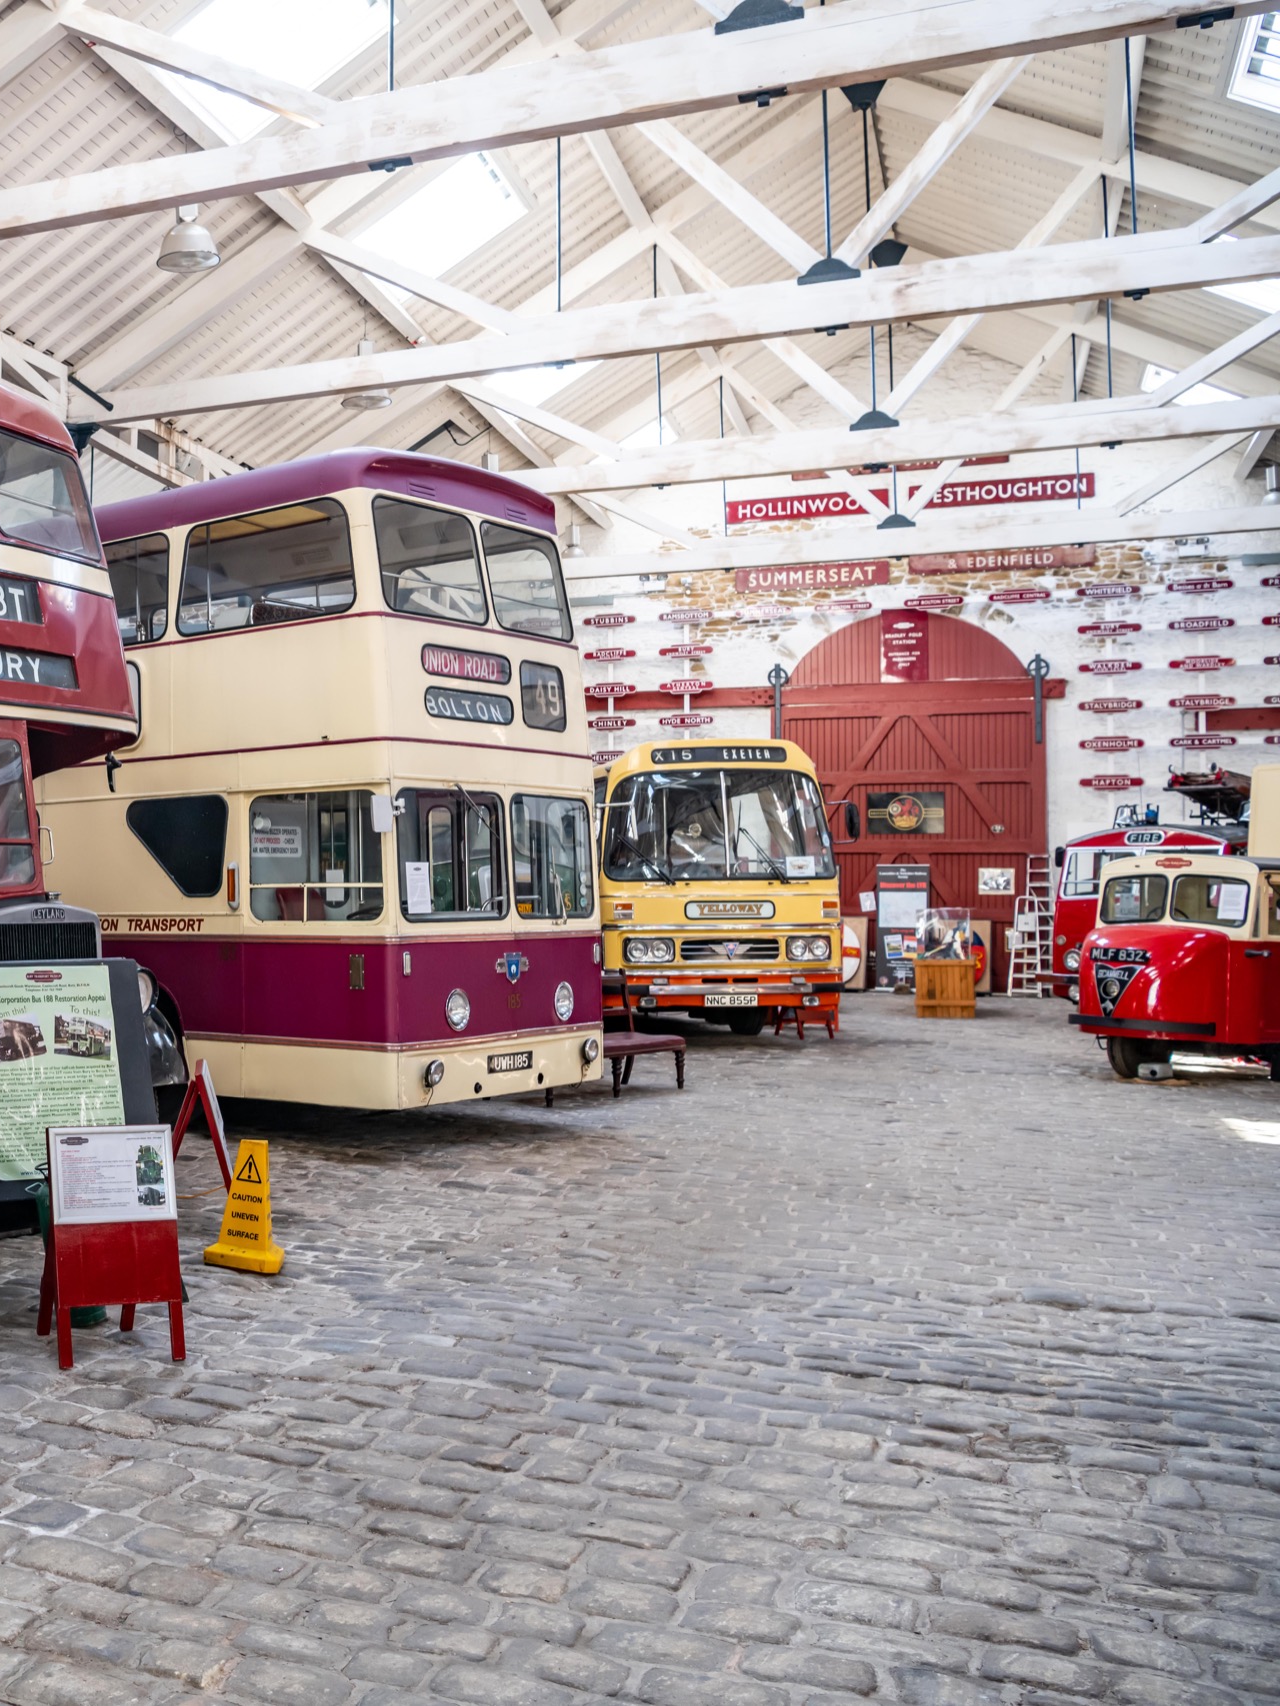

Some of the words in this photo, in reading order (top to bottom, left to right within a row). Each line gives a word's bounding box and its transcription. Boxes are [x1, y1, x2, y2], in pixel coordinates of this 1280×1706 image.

[914, 478, 1087, 503] ESTHOUGHTON
[738, 497, 860, 519] HOLLINWOO
[967, 553, 1054, 568] EDENFIELD
[748, 566, 876, 587] SUMMERSEAT
[1085, 586, 1132, 595] WHITEFIELD
[590, 616, 629, 625] STUBBINS
[663, 611, 709, 620] RAMSBOTTOM
[1174, 620, 1229, 629] BROADFIELD
[464, 655, 497, 680] ROAD
[536, 680, 561, 716] 49
[1175, 697, 1230, 707] STALYBRIDGE
[425, 694, 505, 723] BOLTON
[1084, 701, 1137, 710] STALYBRIDGE
[1085, 740, 1138, 749] OXENHOLME
[1202, 737, 1233, 745] CARTMEL
[1092, 778, 1131, 786] HAPTON
[1129, 832, 1160, 843] FIRE
[33, 908, 65, 920] LEYLAND
[696, 904, 764, 916] YELLOWAY
[127, 918, 205, 932] TRANSPORT
[1091, 948, 1116, 959] MLF
[1118, 950, 1145, 962] 832
[1098, 968, 1129, 981] SCAMMELL
[32, 995, 42, 1003] Bus
[43, 994, 53, 1003] 188
[55, 993, 87, 1003] Restoration
[88, 993, 106, 1003] Appeal
[508, 994, 521, 1009] 185
[706, 996, 727, 1005] NNC
[729, 996, 756, 1005] 855P
[12, 1005, 27, 1016] this!
[69, 1005, 80, 1014] To
[83, 1007, 101, 1017] this!
[231, 1192, 263, 1204] CAUTION
[231, 1210, 259, 1222] UNEVEN
[227, 1228, 259, 1241] SURFACE
